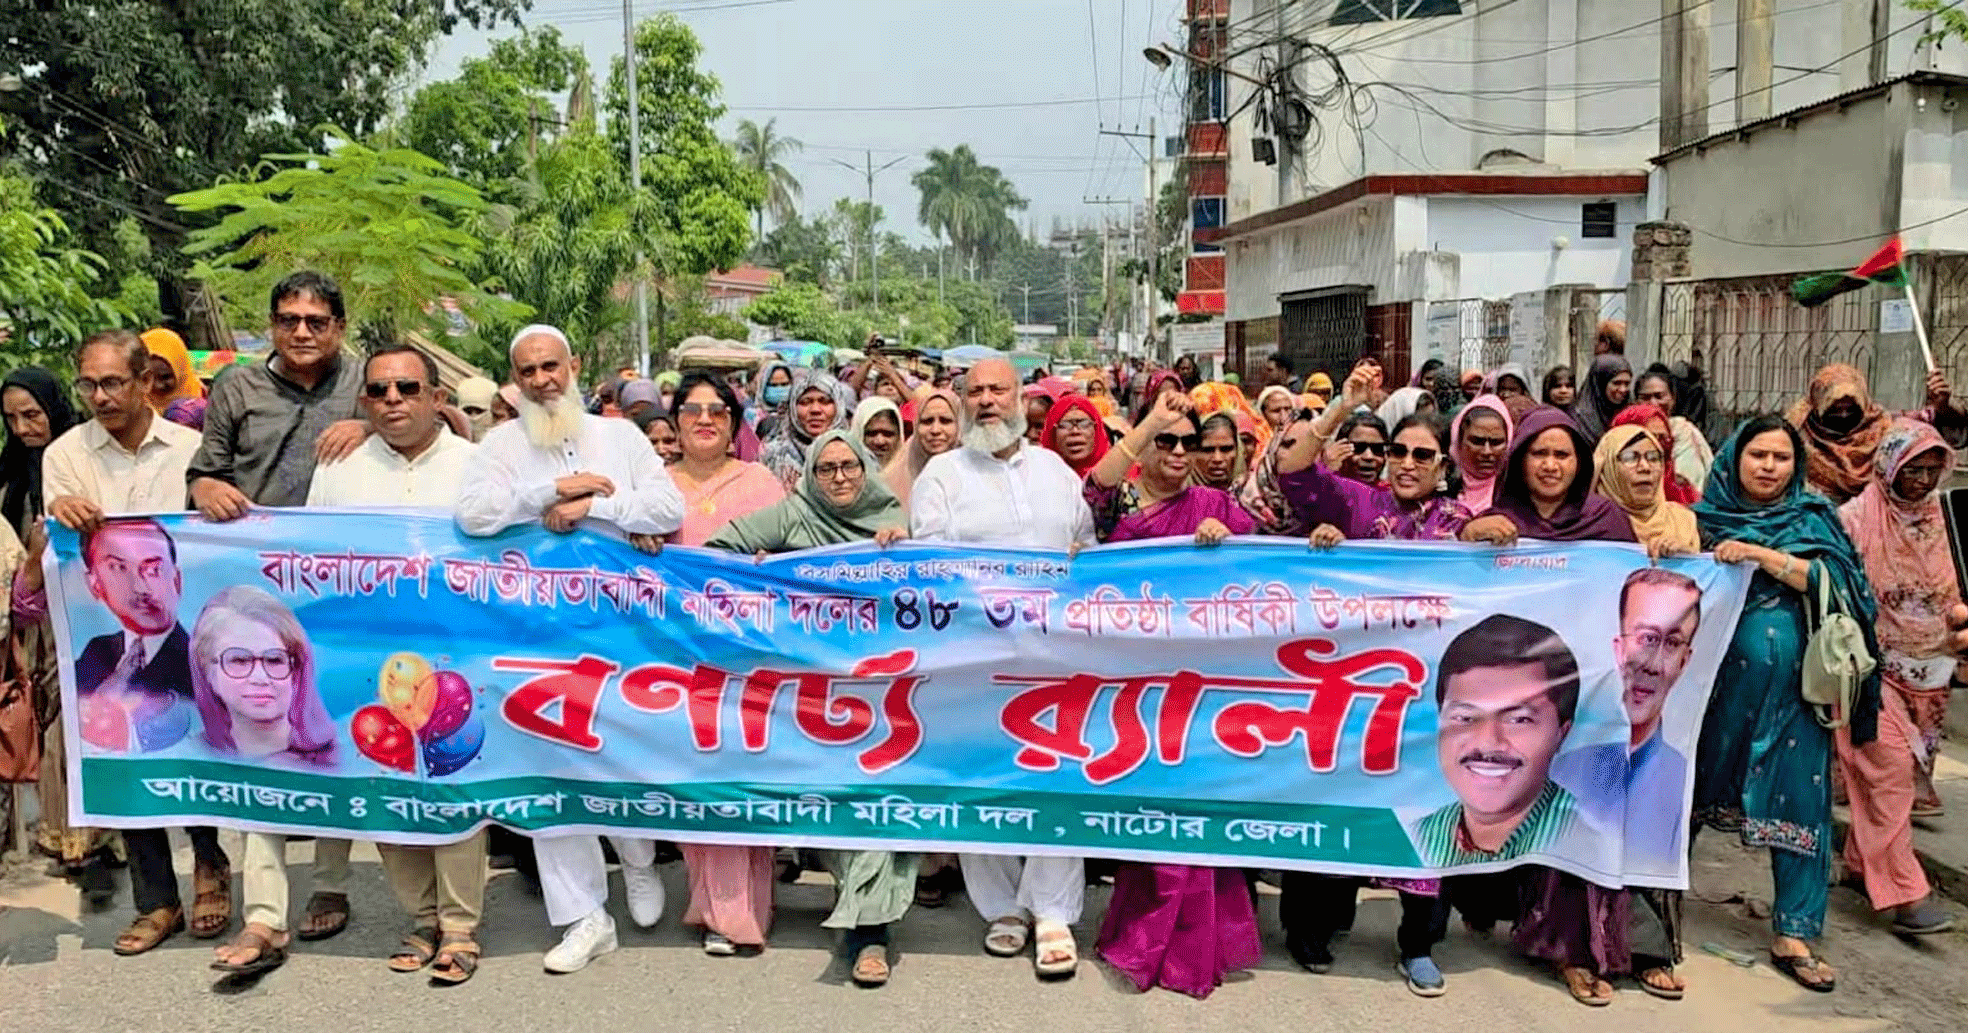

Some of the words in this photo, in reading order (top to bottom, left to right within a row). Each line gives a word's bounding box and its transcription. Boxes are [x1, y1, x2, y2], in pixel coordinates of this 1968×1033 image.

[258, 549, 432, 597] বাংলাদেশ
[441, 550, 668, 617] জাতীয়তাবাদী
[680, 577, 778, 636] মহিলা
[786, 593, 880, 633] দলের
[892, 586, 960, 633] ৪৮
[1064, 583, 1175, 637] প্রতিষ্ঠা
[1181, 582, 1299, 636] বার্ষিকী
[1307, 584, 1454, 633] উপলক্ষে
[141, 776, 334, 816] আয়োজনে
[384, 791, 568, 824] বাংলাদেশ
[579, 792, 837, 824] জাতীয়তাবাদী
[850, 795, 962, 831] মহিলা
[973, 804, 1040, 832] দল
[1080, 806, 1211, 840] নাটোর
[1224, 818, 1329, 848] জেলা
